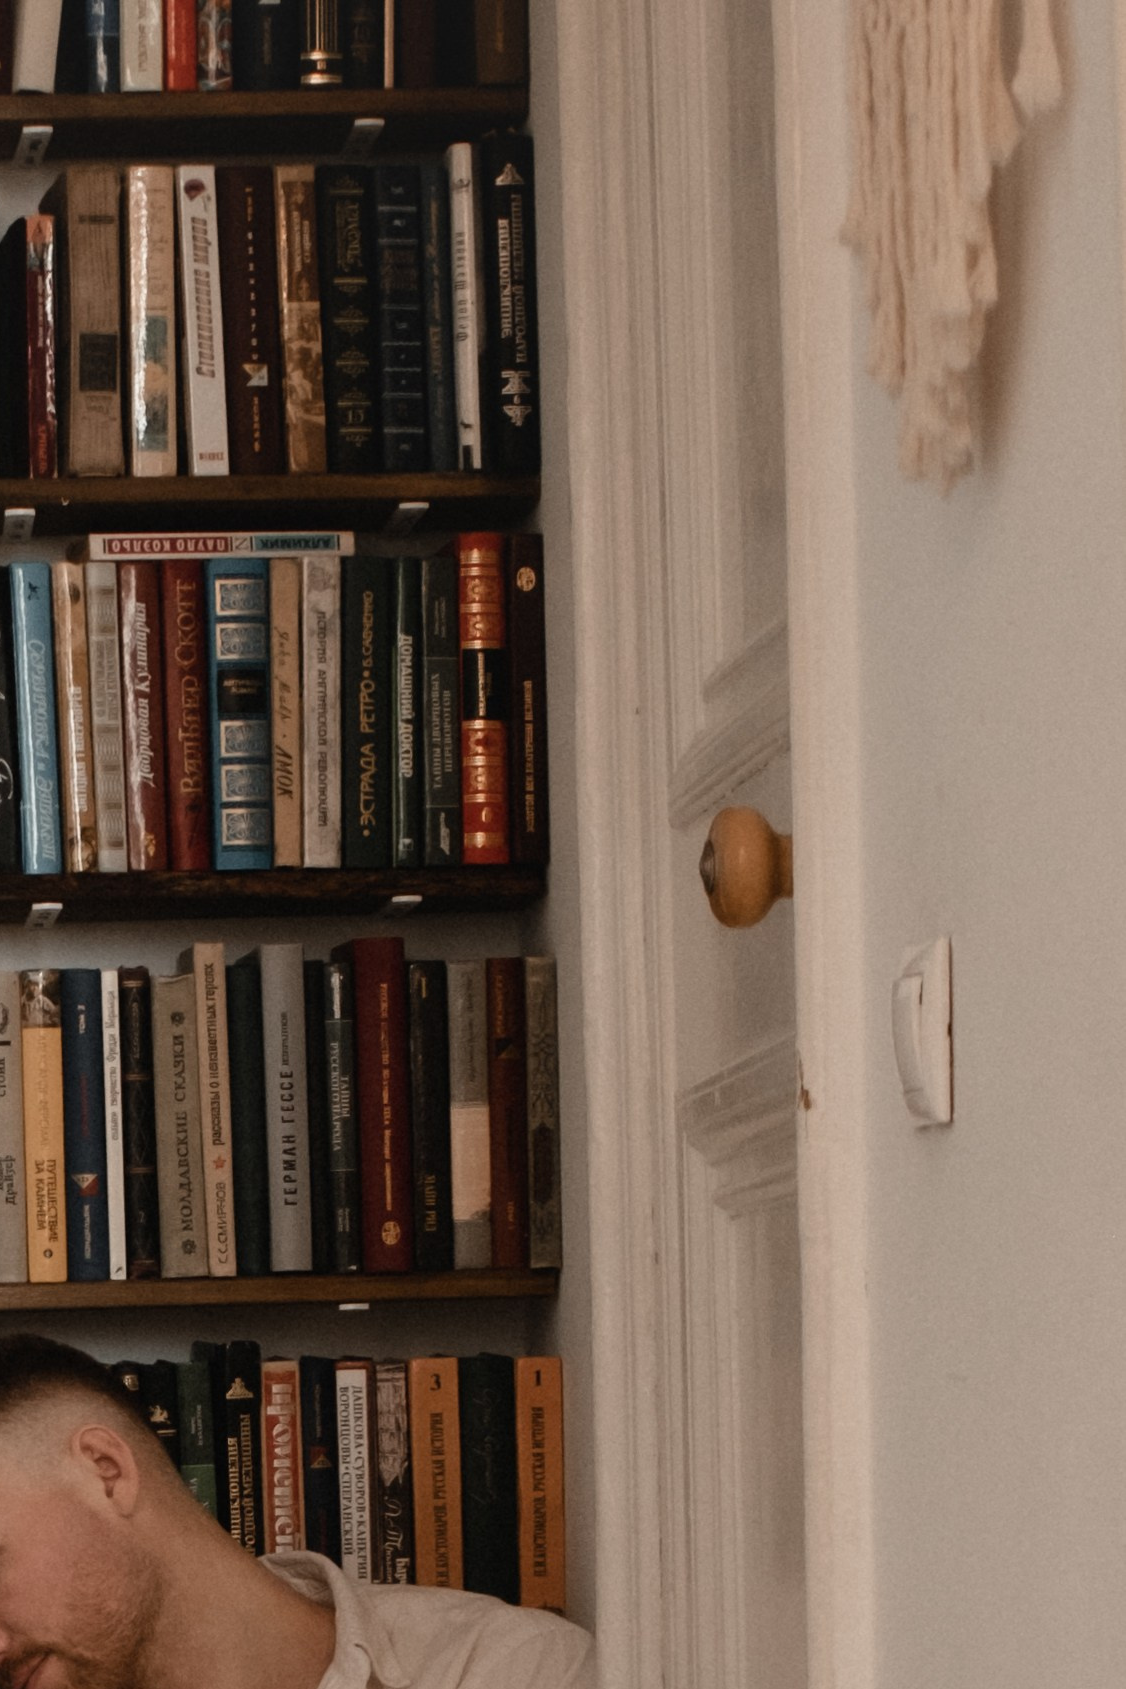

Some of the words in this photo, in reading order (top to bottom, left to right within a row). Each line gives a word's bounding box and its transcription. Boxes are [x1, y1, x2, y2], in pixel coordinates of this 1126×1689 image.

[190, 216, 212, 266] миров
[497, 218, 514, 338] ЭНЦИКЛОПЕДИЯ
[512, 285, 527, 362] НАРОДНОЙ
[111, 539, 171, 554] КОЭЛЬО
[176, 538, 226, 552] ПАУЛО
[133, 601, 151, 692] Кулинария
[317, 610, 327, 665] ИСТОРИЯ
[361, 590, 374, 668] Б.САВЧЕНКО
[317, 667, 328, 747] АНГЛИЙСКОЙ
[359, 678, 375, 734] РЕТРО
[398, 633, 415, 719] ДОМАШНИЙ
[431, 673, 442, 746] ДВОРЦОВЫХ
[442, 690, 453, 772] ПЕРЕВОРОТОВ
[136, 697, 156, 787] Дворцовая
[399, 722, 414, 778] ДОКТОР
[432, 747, 443, 788] ТАЙНЫ
[318, 751, 329, 827] РЕВОЛЮЦИИ
[360, 742, 376, 827] ЭСТРАДА
[204, 963, 217, 1000] героях
[173, 1033, 187, 1102] СКАЗКИ
[205, 1003, 218, 1080] неизвестных
[208, 1090, 223, 1147] рассказы
[279, 1070, 295, 1124] ГЕССЕ
[339, 1074, 351, 1118] ТАЙНЫ
[34, 1159, 45, 1170] ЗА
[176, 1111, 193, 1232] МОЛДАВСКИЕ
[282, 1134, 298, 1207] ГЕРМАН
[34, 1171, 46, 1231] КАМНЕМ
[45, 1159, 58, 1243] ПУТЕШЕСТВИЕ
[339, 1384, 352, 1465] ВОРОНЦОВЫ
[351, 1384, 364, 1450] ДАШКОВА
[428, 1411, 445, 1456] ИСТОРИЯ
[529, 1407, 545, 1447] ИСТОРИЯ
[238, 1413, 254, 1495] МЕДИЦИНЫ
[354, 1455, 366, 1514] СУВОРОВ
[431, 1458, 447, 1501] РУССКАЯ
[529, 1449, 546, 1493] РУССКАЯ
[241, 1497, 256, 1554] РОДНОЙ
[341, 1470, 355, 1556] СПЕРАНСКИЙ
[355, 1519, 368, 1579] КАНКРИН
